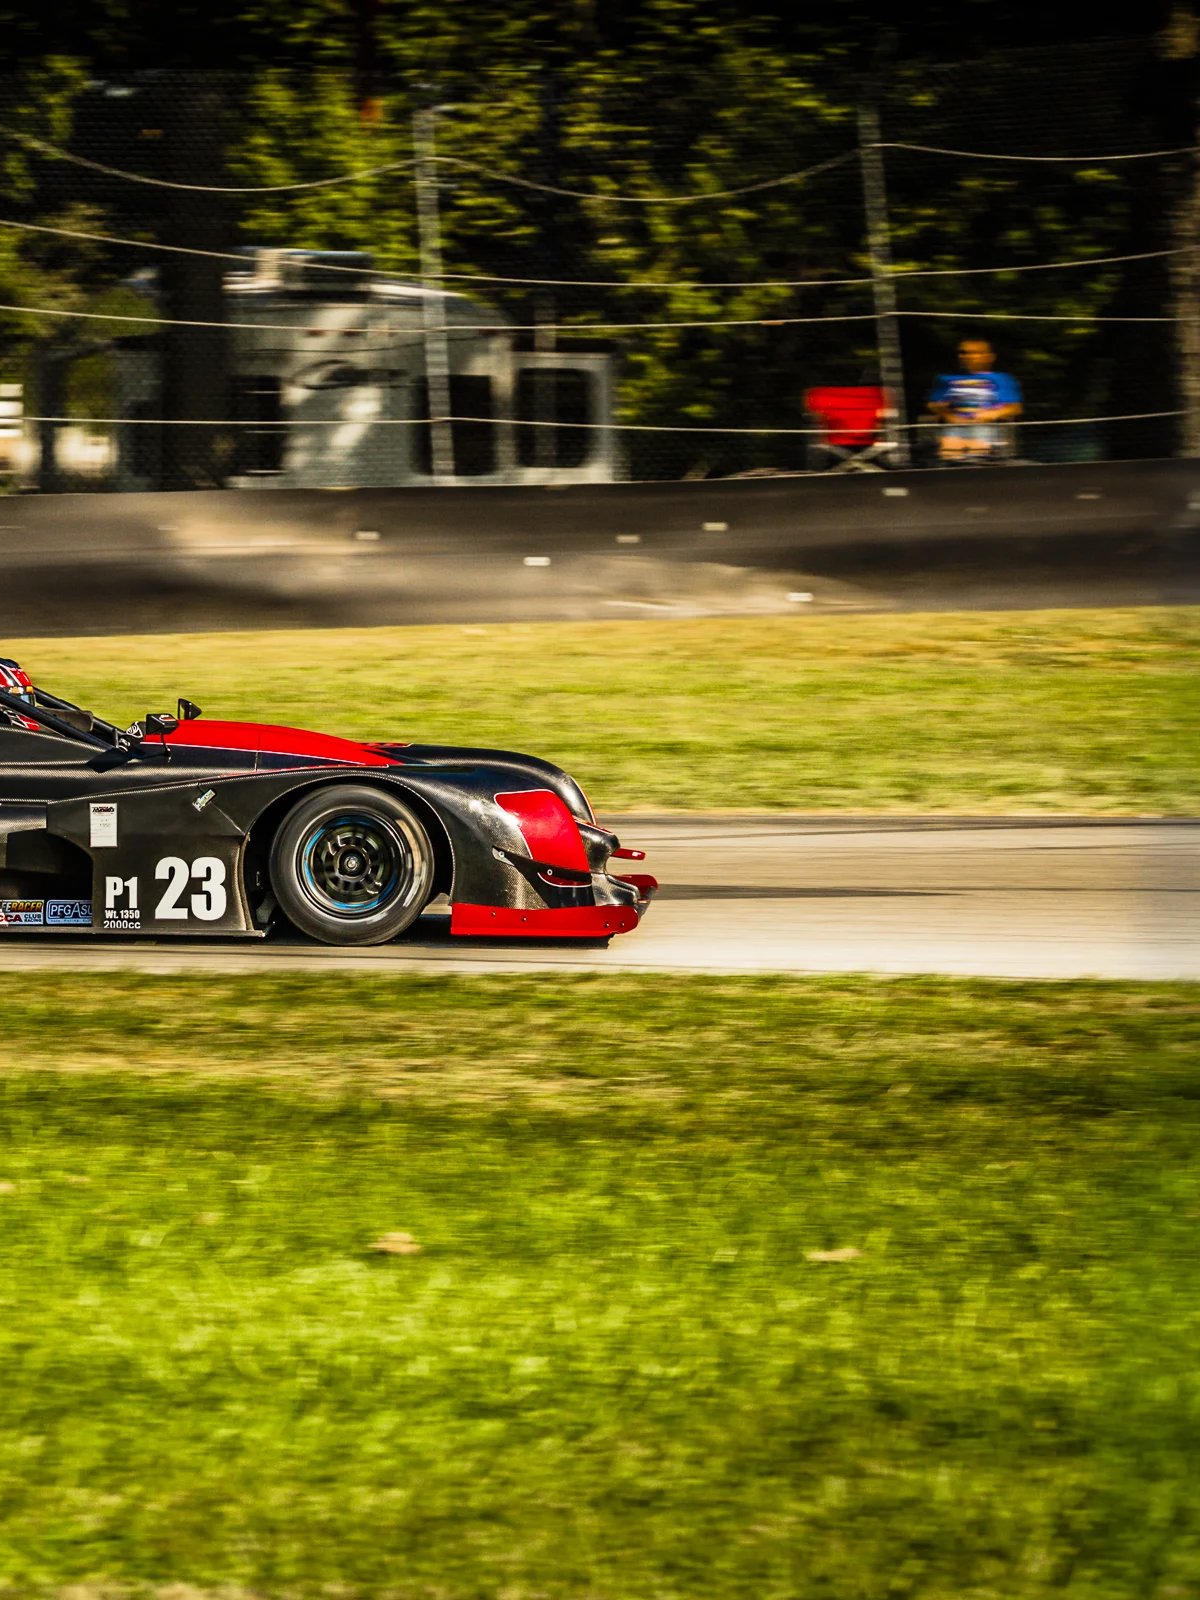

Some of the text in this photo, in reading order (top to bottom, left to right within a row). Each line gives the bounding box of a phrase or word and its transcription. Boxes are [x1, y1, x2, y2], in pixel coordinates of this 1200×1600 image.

[105, 856, 228, 921] P1 23
[104, 909, 141, 919] Wt. 1350
[103, 920, 141, 929] 2000cc
